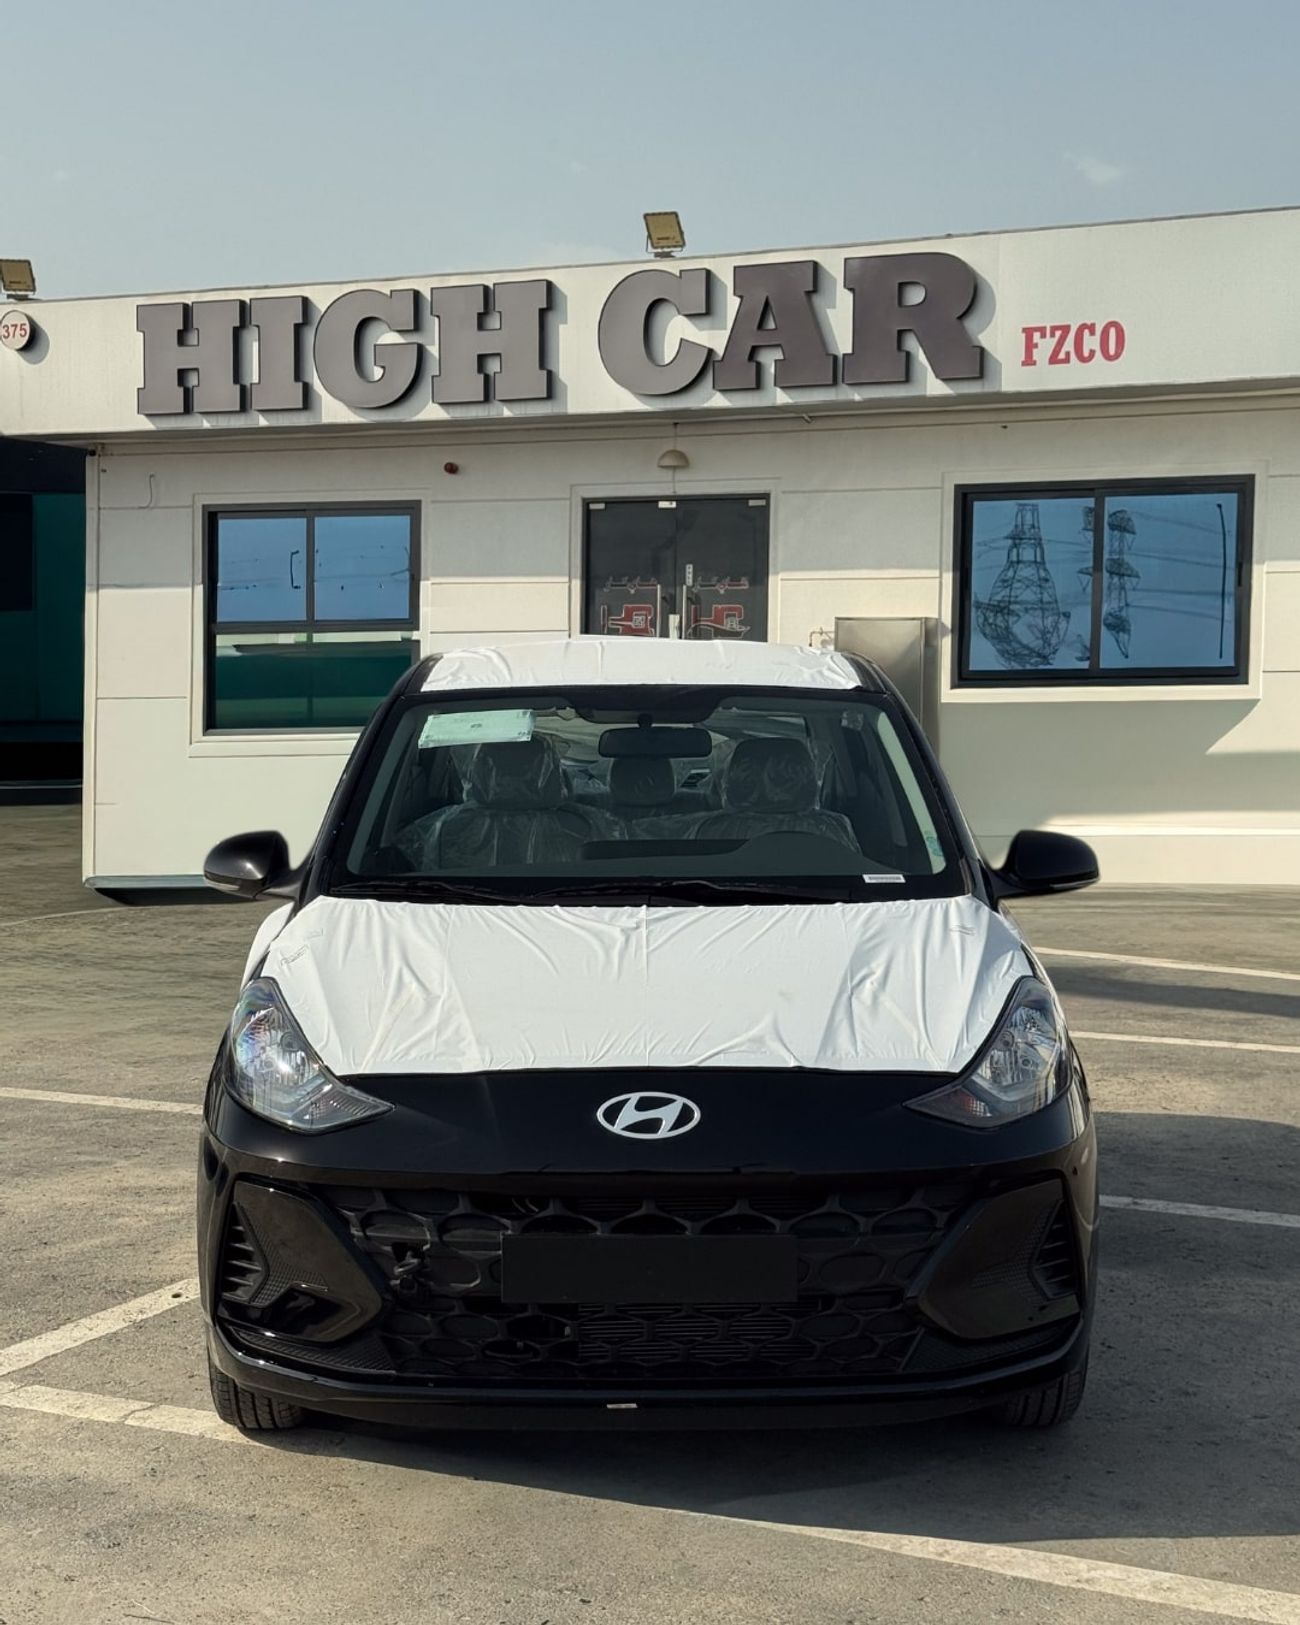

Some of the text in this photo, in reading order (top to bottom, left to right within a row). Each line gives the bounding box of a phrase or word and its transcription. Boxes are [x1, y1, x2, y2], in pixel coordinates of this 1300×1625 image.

[2, 323, 28, 340] 375
[137, 252, 984, 416] HIGH CAR
[1021, 320, 1126, 367] FZCO
